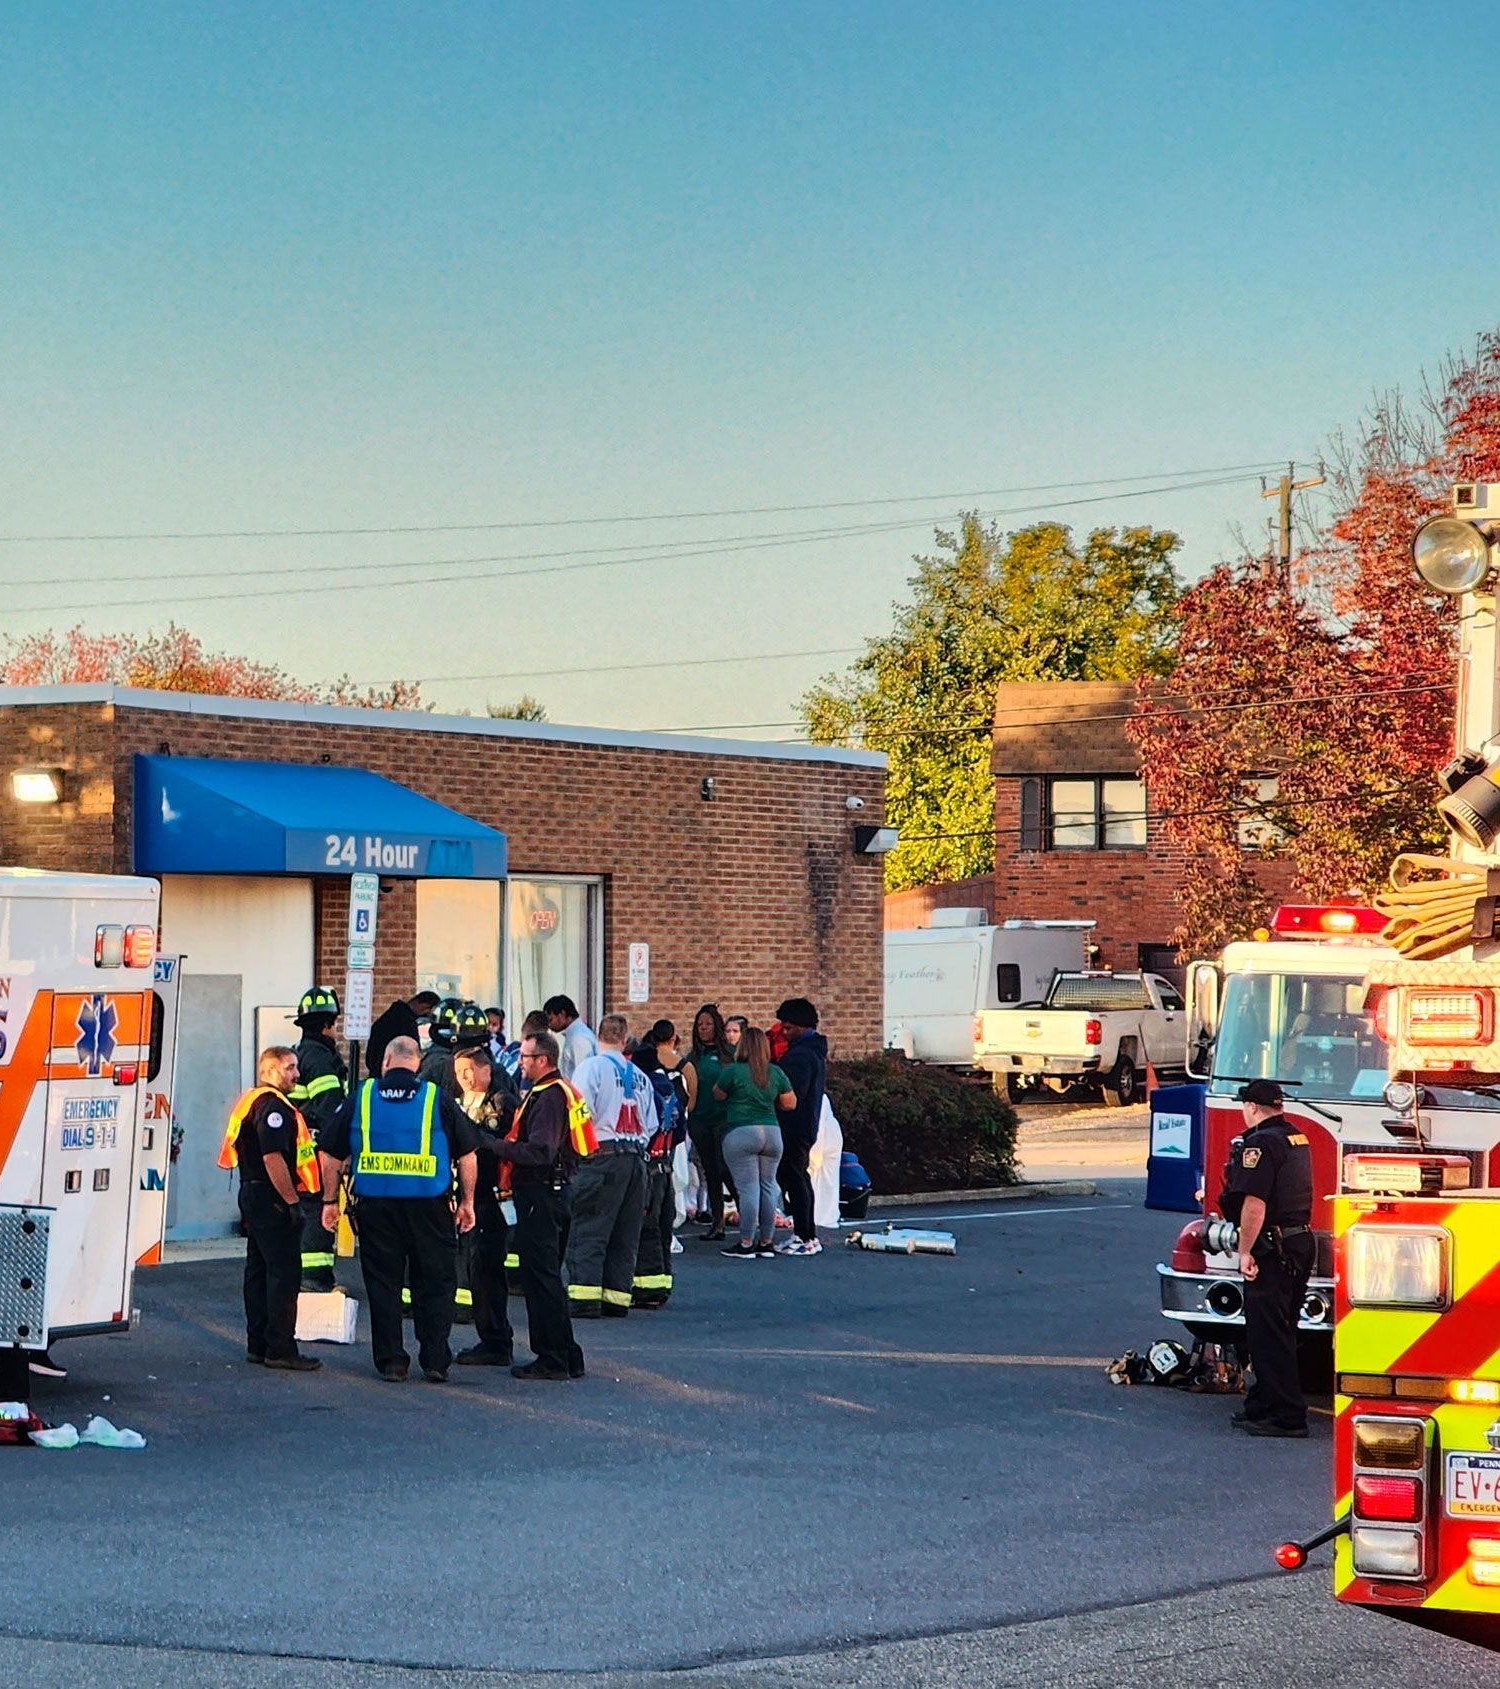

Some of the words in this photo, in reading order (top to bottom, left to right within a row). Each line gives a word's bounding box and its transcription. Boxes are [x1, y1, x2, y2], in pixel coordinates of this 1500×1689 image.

[325, 834, 358, 867] 24
[364, 836, 420, 869] Hour
[529, 910, 557, 930] OPEN
[64, 1100, 119, 1120] EMERGENCY
[62, 1127, 83, 1148] DIAL
[361, 1156, 380, 1171] EMS
[383, 1157, 430, 1173] COMMAND
[1156, 1352, 1171, 1367] 14
